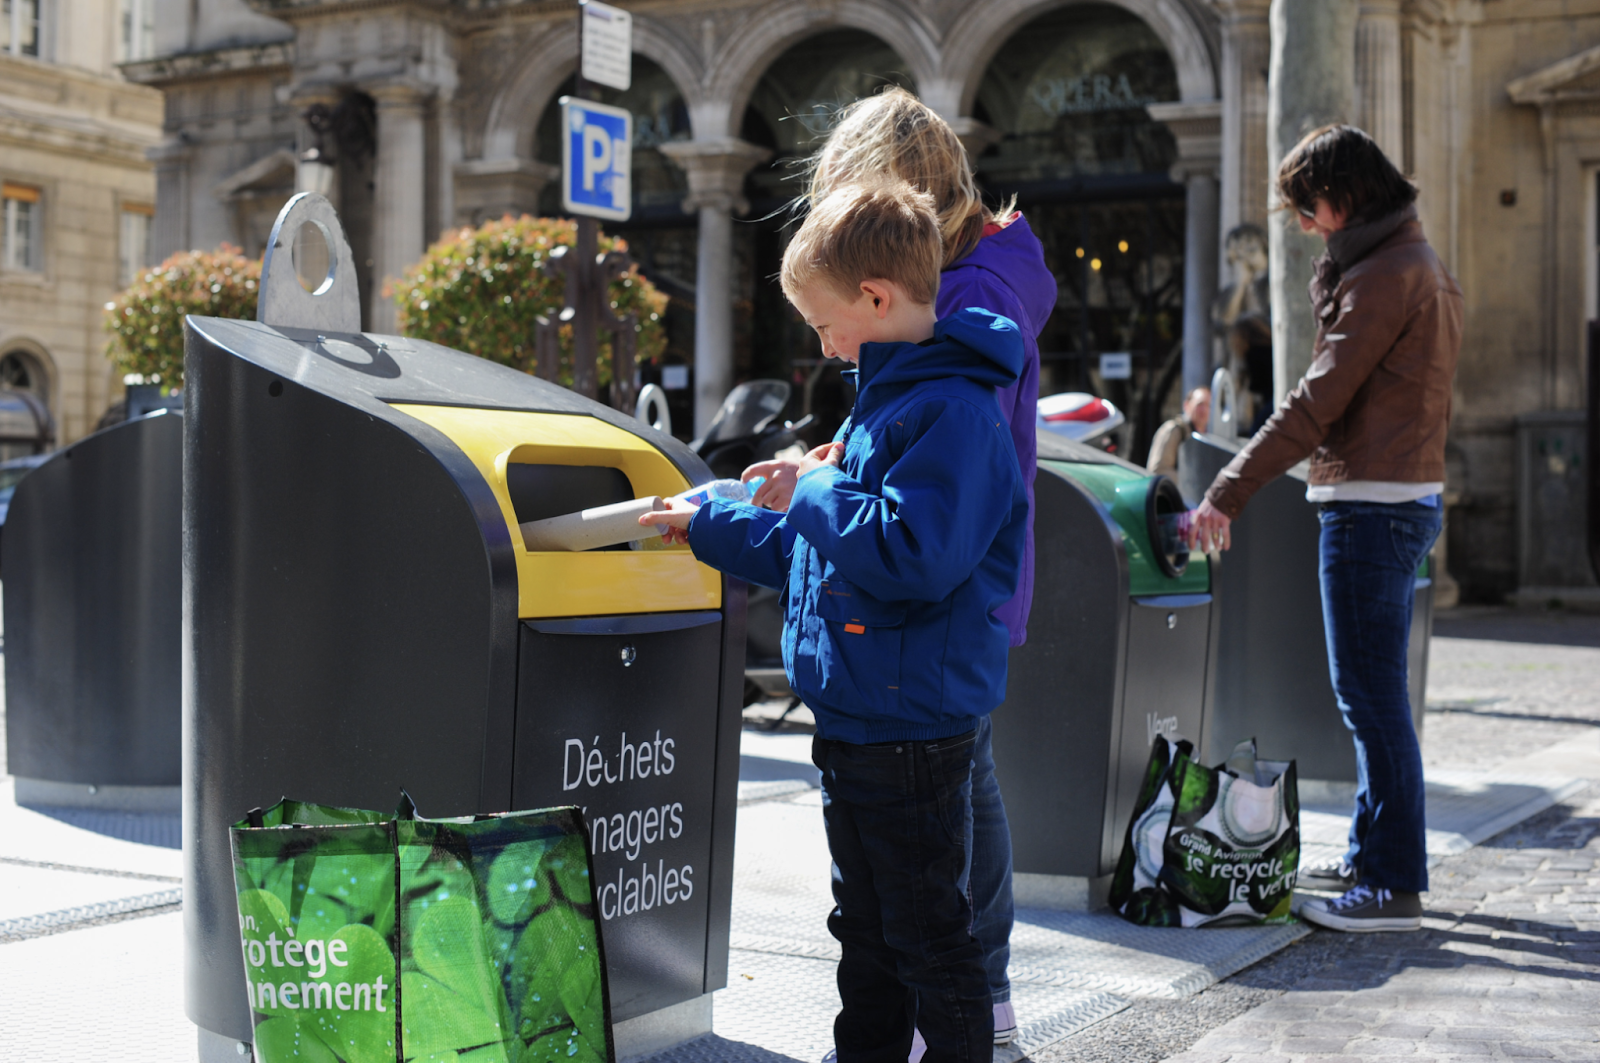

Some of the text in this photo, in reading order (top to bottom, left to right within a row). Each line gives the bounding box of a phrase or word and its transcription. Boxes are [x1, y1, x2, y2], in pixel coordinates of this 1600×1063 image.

[583, 124, 612, 191] P
[563, 729, 675, 791] Déchets
[582, 802, 683, 861] nagers
[1179, 833, 1212, 856] Grand
[1185, 849, 1204, 873] je
[597, 859, 693, 920] clables
[1228, 879, 1250, 902] le
